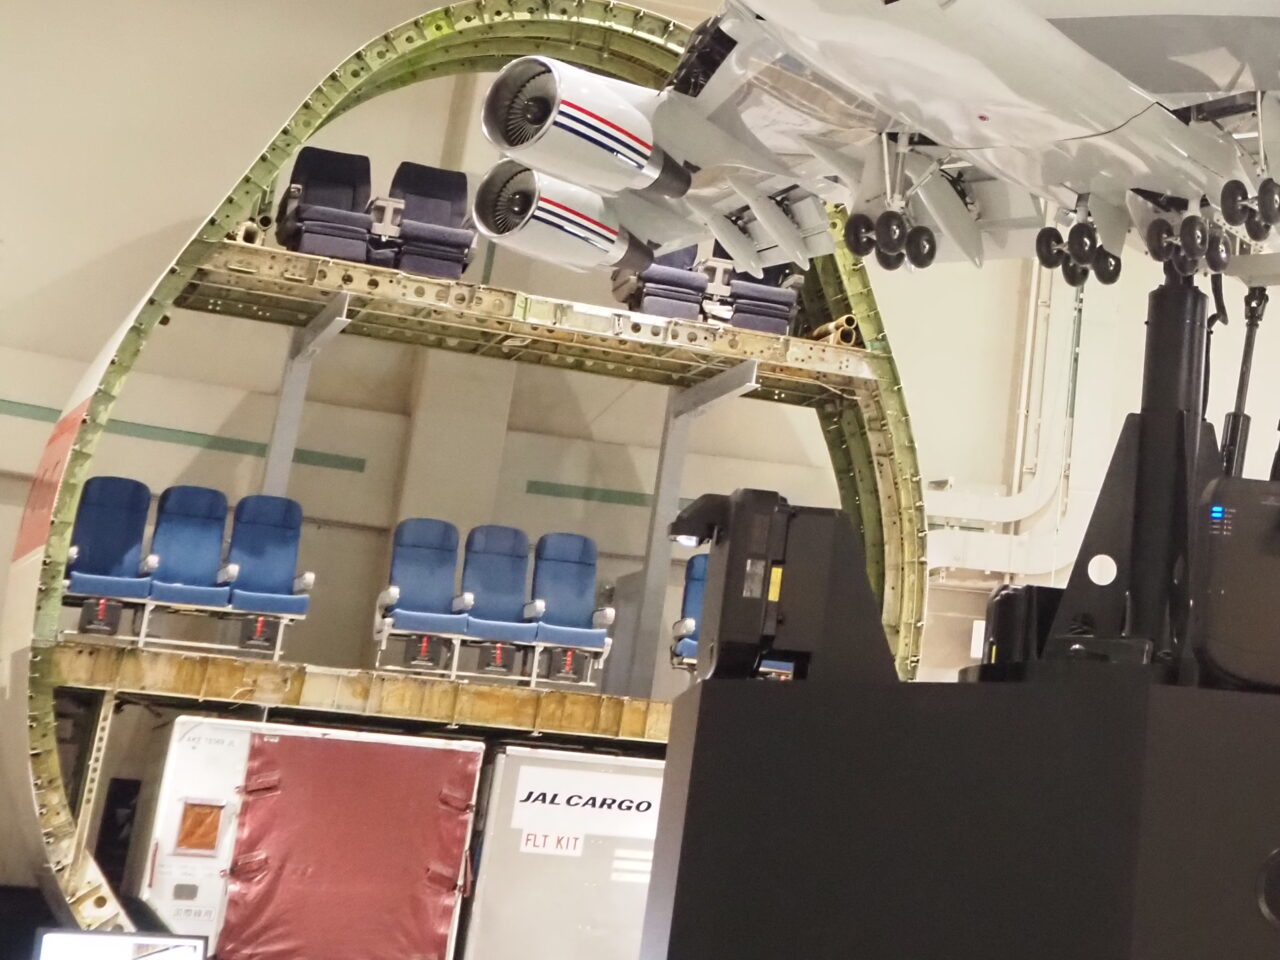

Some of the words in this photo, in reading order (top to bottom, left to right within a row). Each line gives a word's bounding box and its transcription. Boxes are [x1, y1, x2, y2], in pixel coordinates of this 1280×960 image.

[519, 790, 561, 806] JAL
[565, 794, 652, 813] CARGO
[525, 833, 550, 848] FLT
[555, 835, 580, 851] KIT
